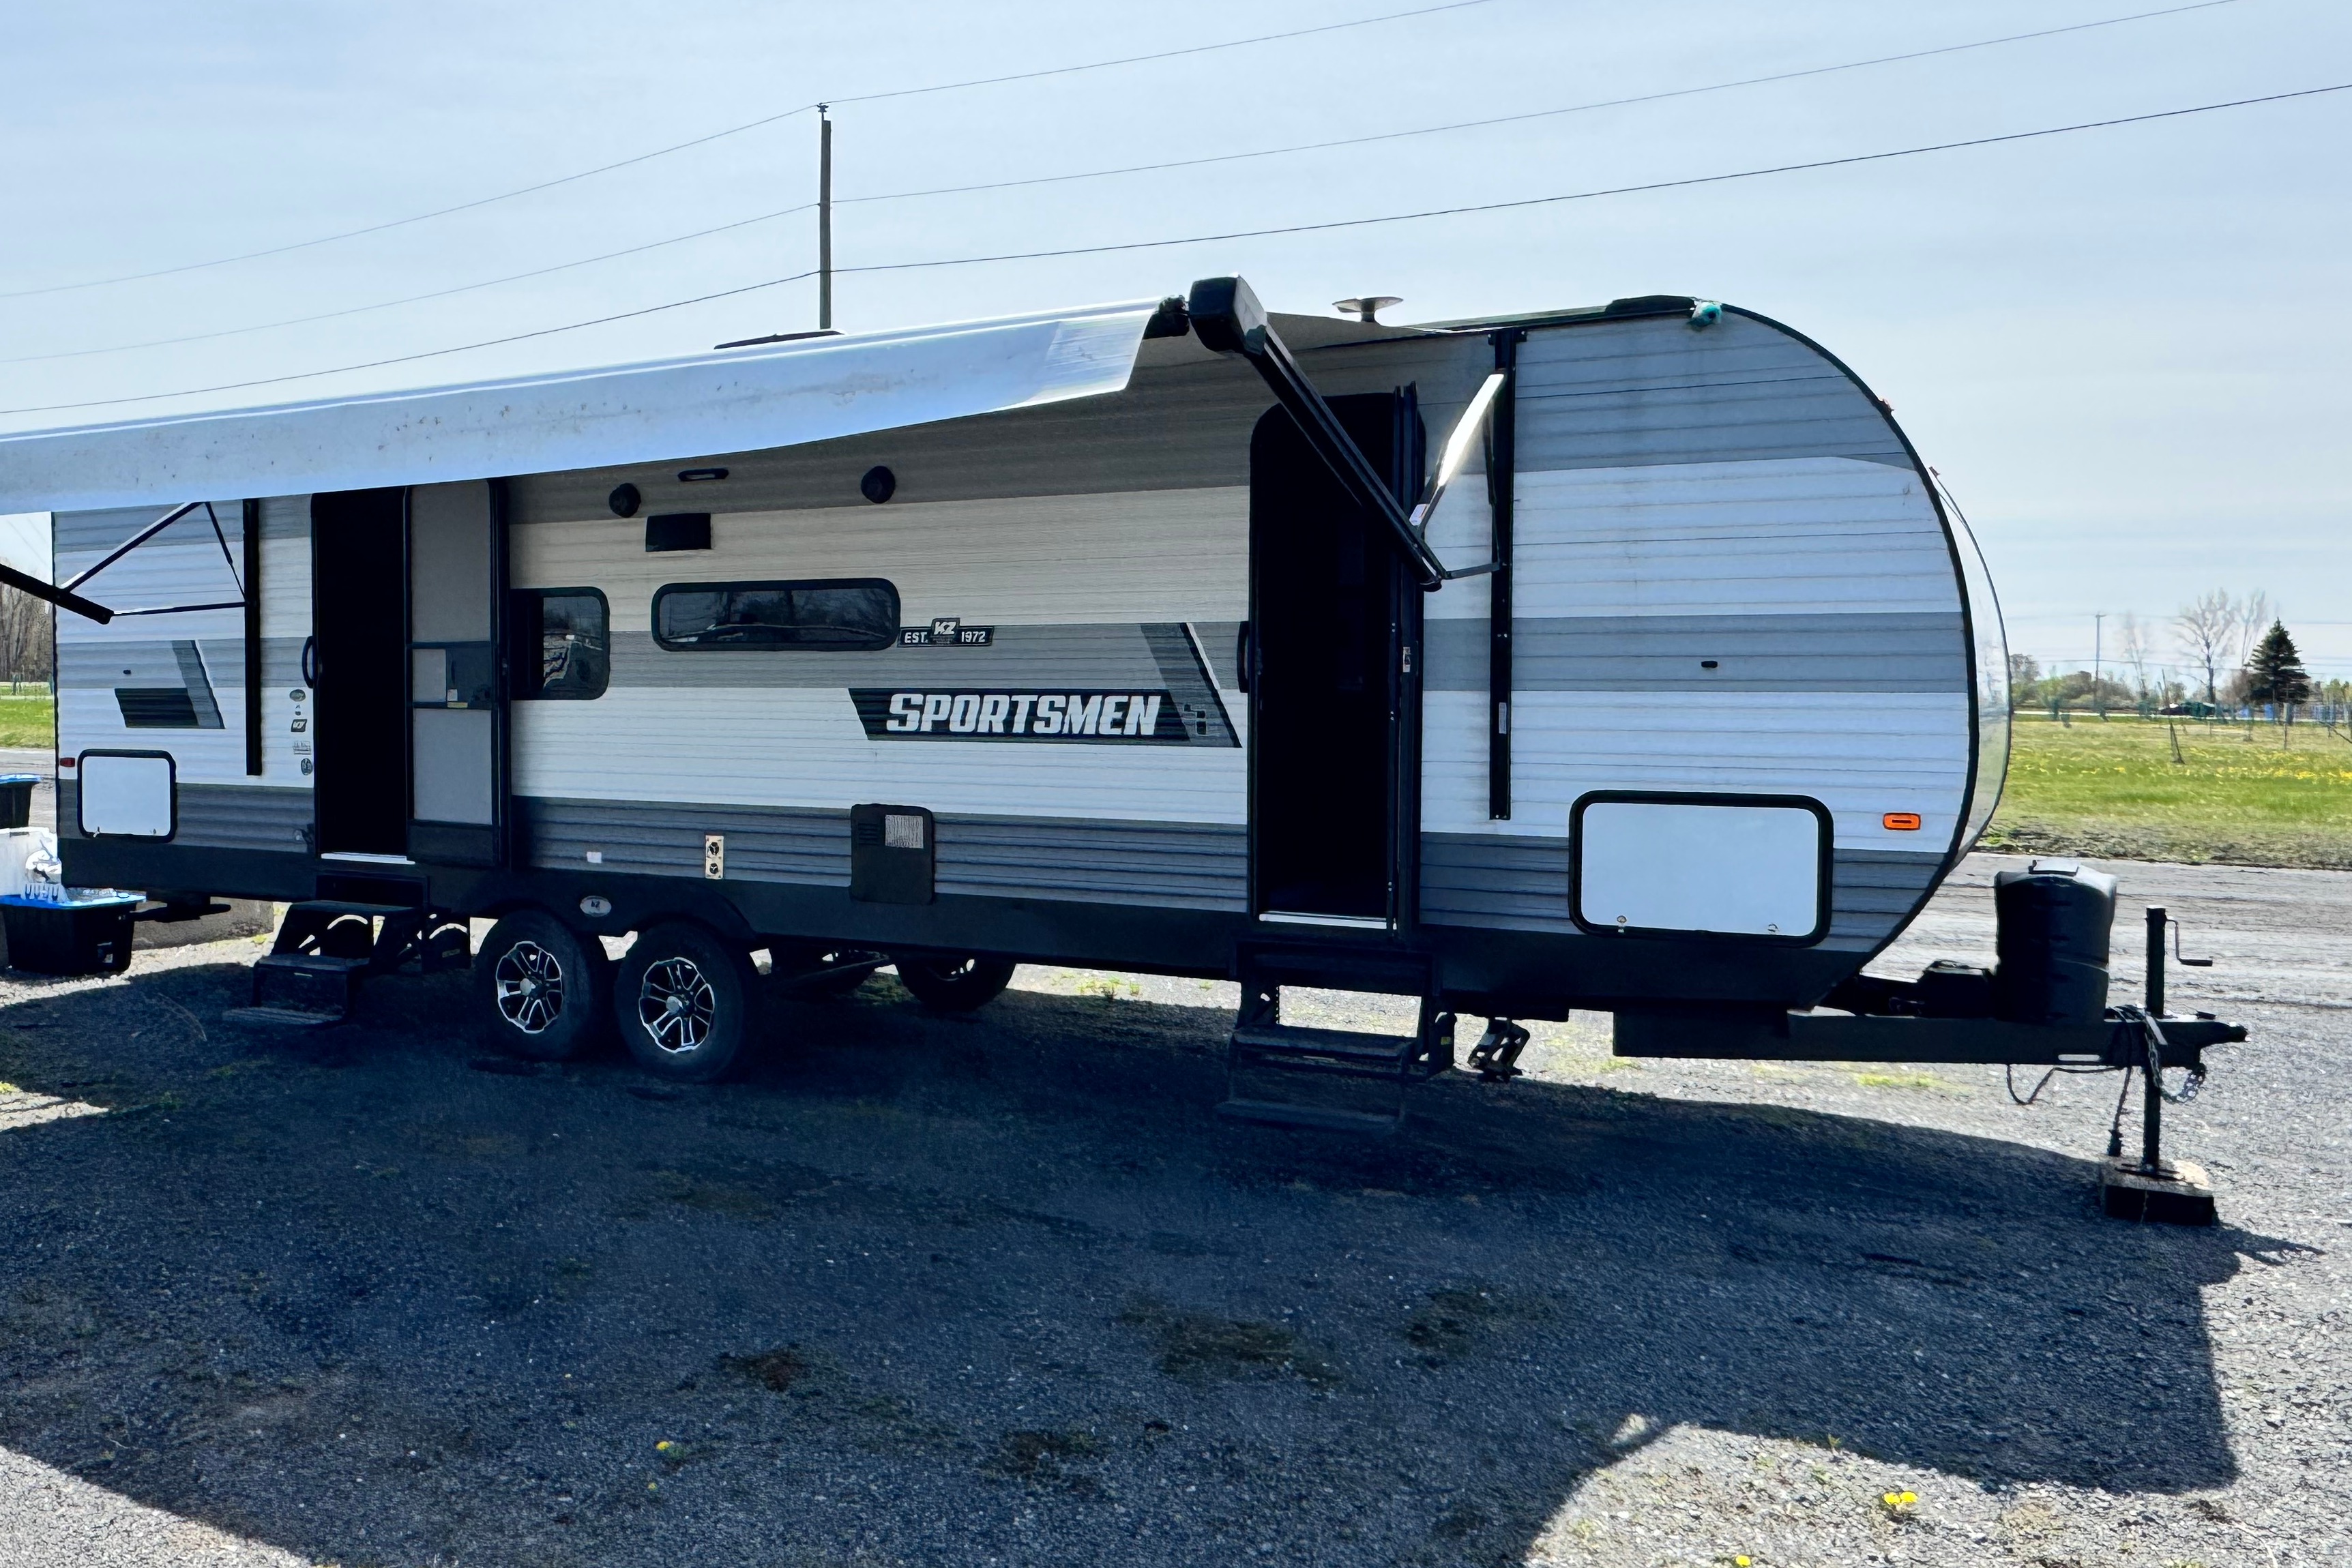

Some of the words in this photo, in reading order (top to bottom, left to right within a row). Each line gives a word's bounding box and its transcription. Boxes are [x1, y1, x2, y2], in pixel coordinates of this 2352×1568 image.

[904, 632, 928, 644] EST.
[933, 621, 956, 635] KZ
[961, 631, 986, 642] 1972
[887, 694, 1161, 736] SPORTSMEN
